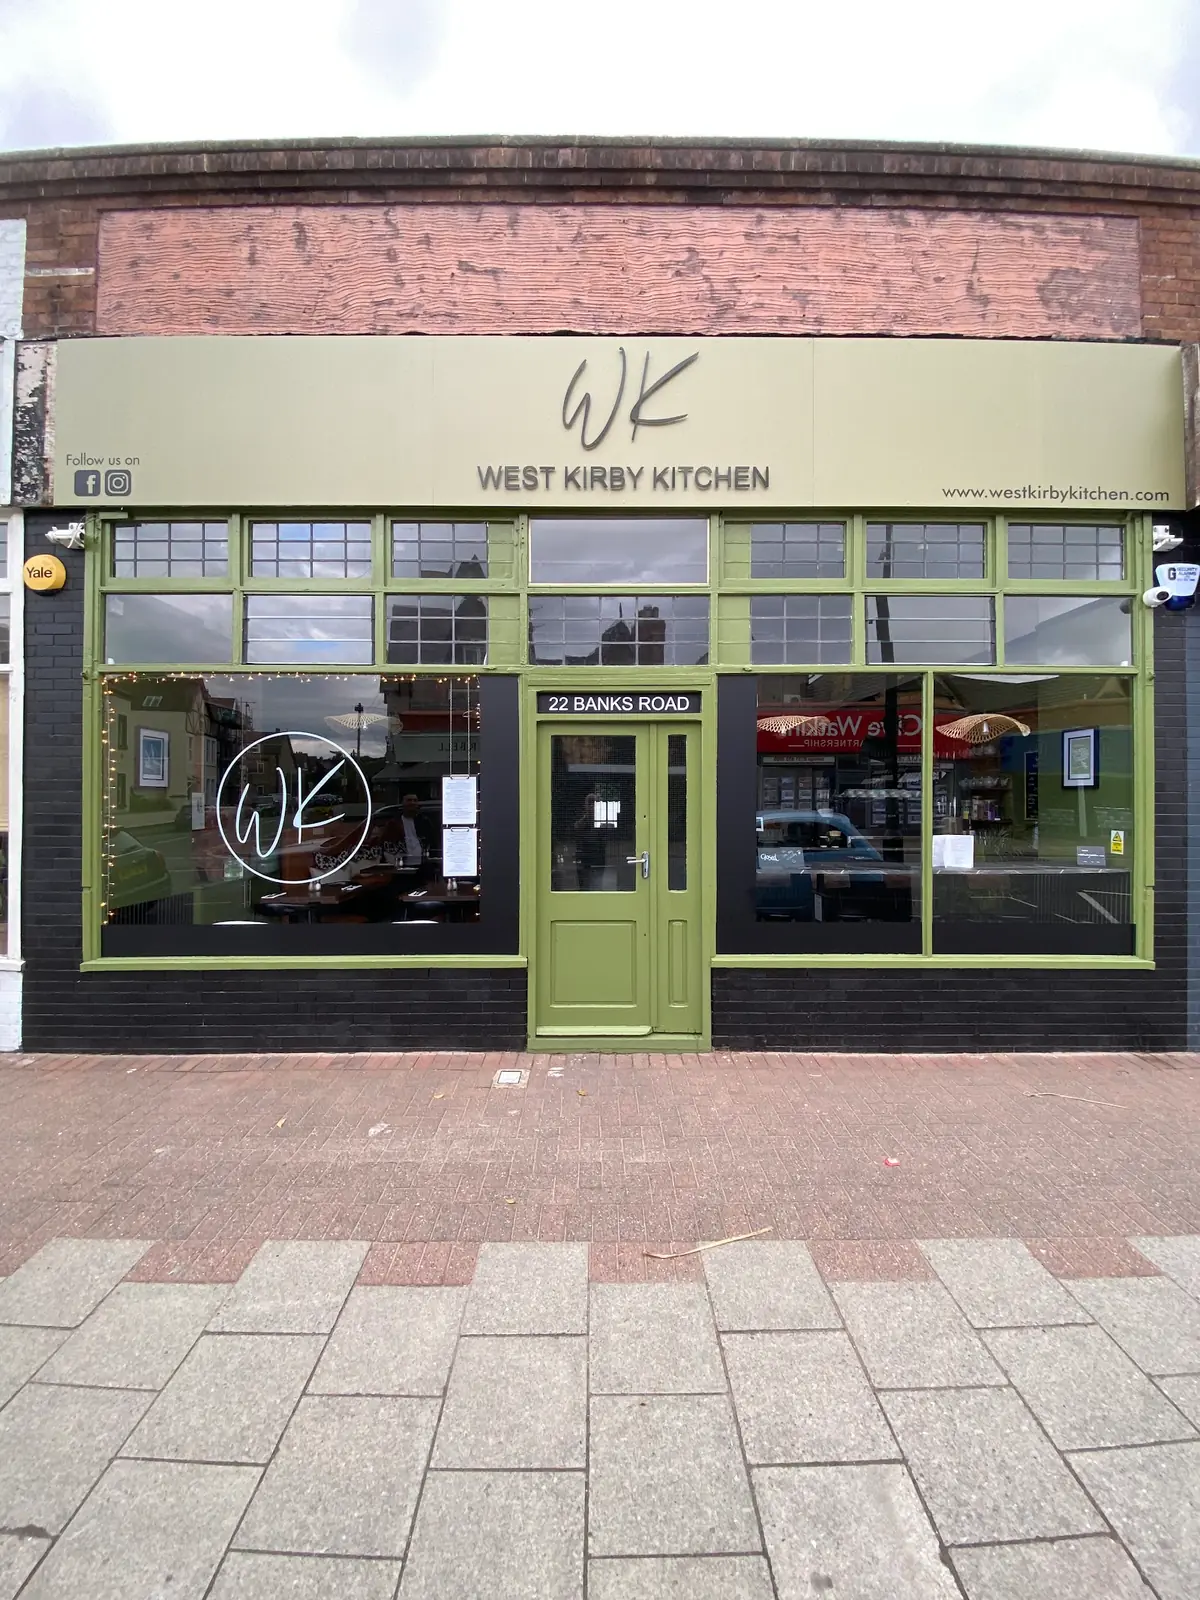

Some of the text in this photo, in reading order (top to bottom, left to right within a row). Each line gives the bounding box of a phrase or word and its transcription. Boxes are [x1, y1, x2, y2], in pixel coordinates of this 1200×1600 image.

[66, 452, 140, 466] Follow us on
[476, 465, 770, 490] WEST KIRBY KITCHEN
[941, 484, 1170, 503] www.westkirbykitchen.com
[26, 566, 53, 579] Yale
[1168, 567, 1177, 581] G
[548, 696, 690, 711] 22 BANKS ROAD
